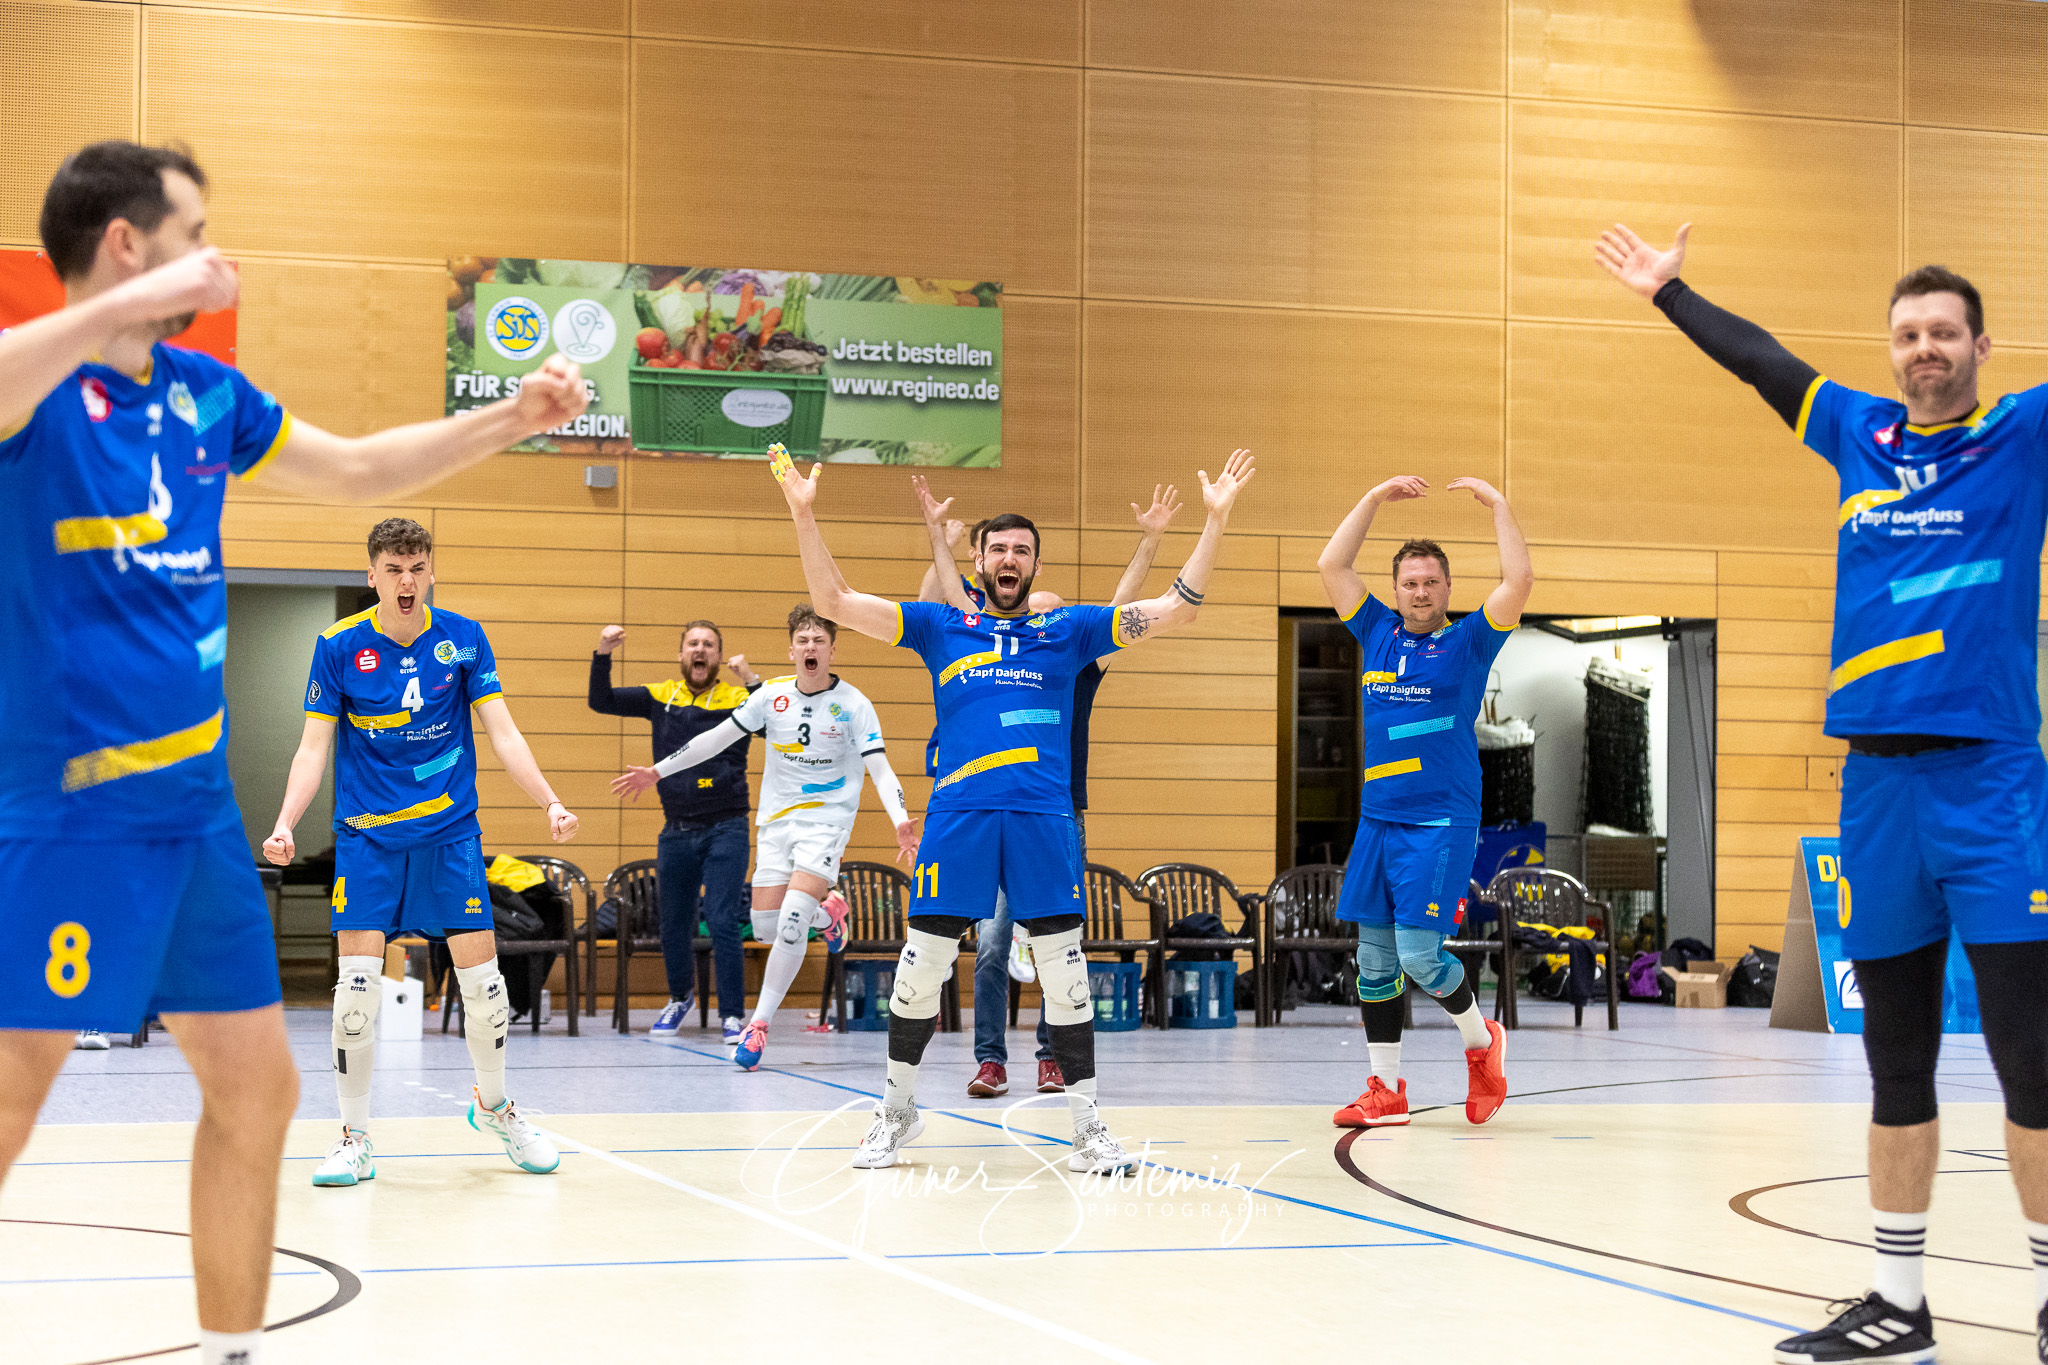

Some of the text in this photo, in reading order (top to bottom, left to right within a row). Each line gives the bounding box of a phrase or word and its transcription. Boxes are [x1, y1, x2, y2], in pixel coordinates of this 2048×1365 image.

[833, 338, 993, 366] Jetzt bestellen
[454, 370, 500, 398] FÜR
[832, 375, 1000, 403] www.regineo.de
[989, 632, 1019, 656] 11
[968, 668, 1043, 681] Zapf Daigfuss
[401, 676, 425, 713] 4
[1371, 682, 1432, 696] Zapf Daigfuss
[797, 722, 811, 746] 3
[697, 778, 713, 788] SK
[915, 862, 939, 899] 11
[331, 876, 347, 914] 4
[45, 921, 92, 999] 8
